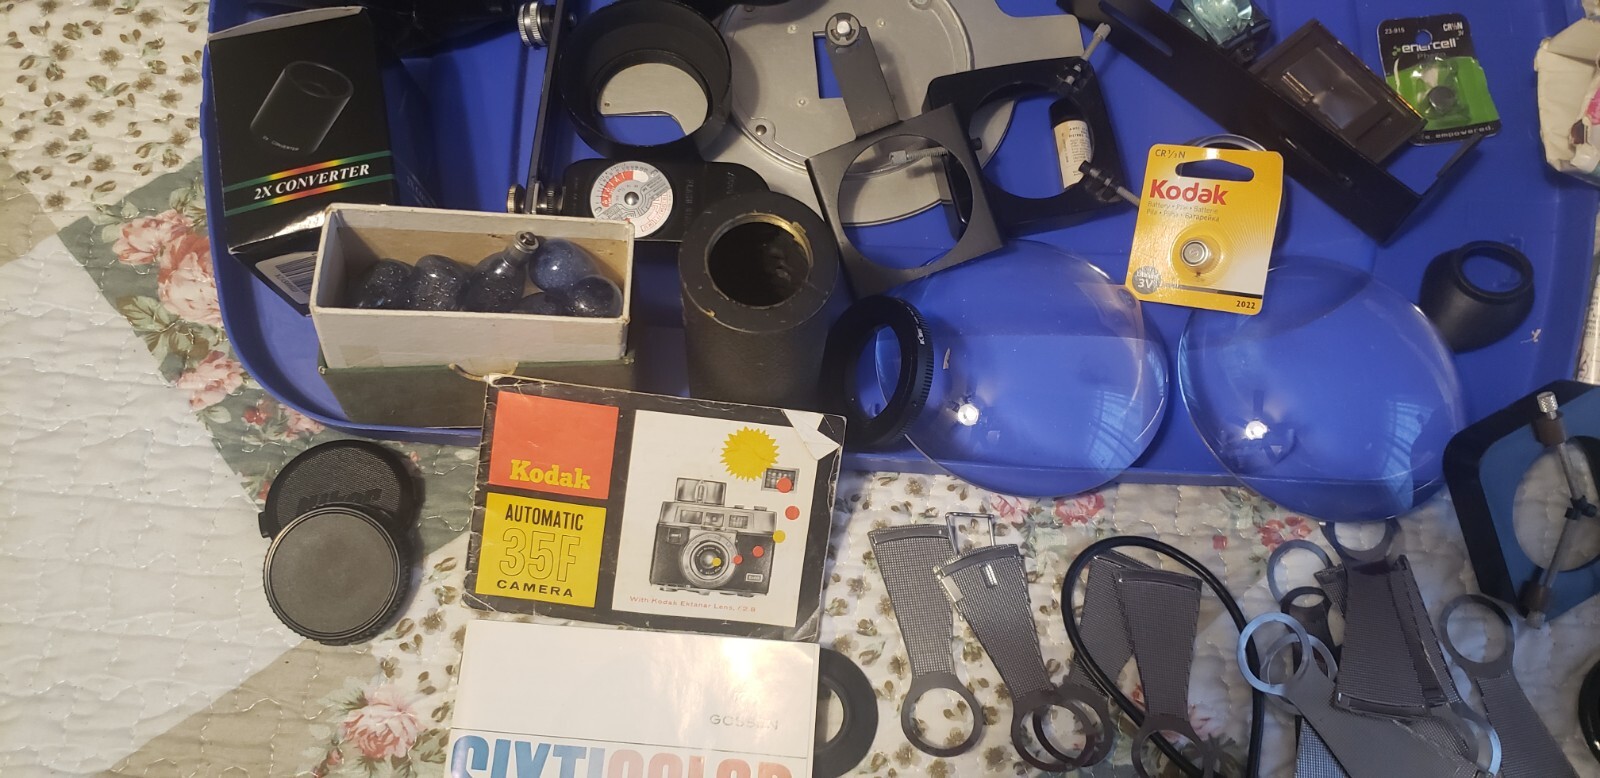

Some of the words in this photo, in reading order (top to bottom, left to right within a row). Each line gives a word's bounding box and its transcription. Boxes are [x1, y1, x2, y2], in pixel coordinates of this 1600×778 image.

[254, 185, 272, 200] 2X
[275, 164, 370, 195] CONVERTER
[1149, 178, 1229, 206] Kodak
[1137, 278, 1154, 289] 3V
[1236, 300, 1256, 310] 2022
[509, 459, 591, 490] Kodak
[505, 503, 584, 531] AUTOMATIC
[499, 527, 581, 582] 35F
[496, 579, 573, 598] CAMERA
[629, 595, 649, 604] With
[651, 597, 678, 606] Kodak
[708, 713, 779, 732] GOSSN
